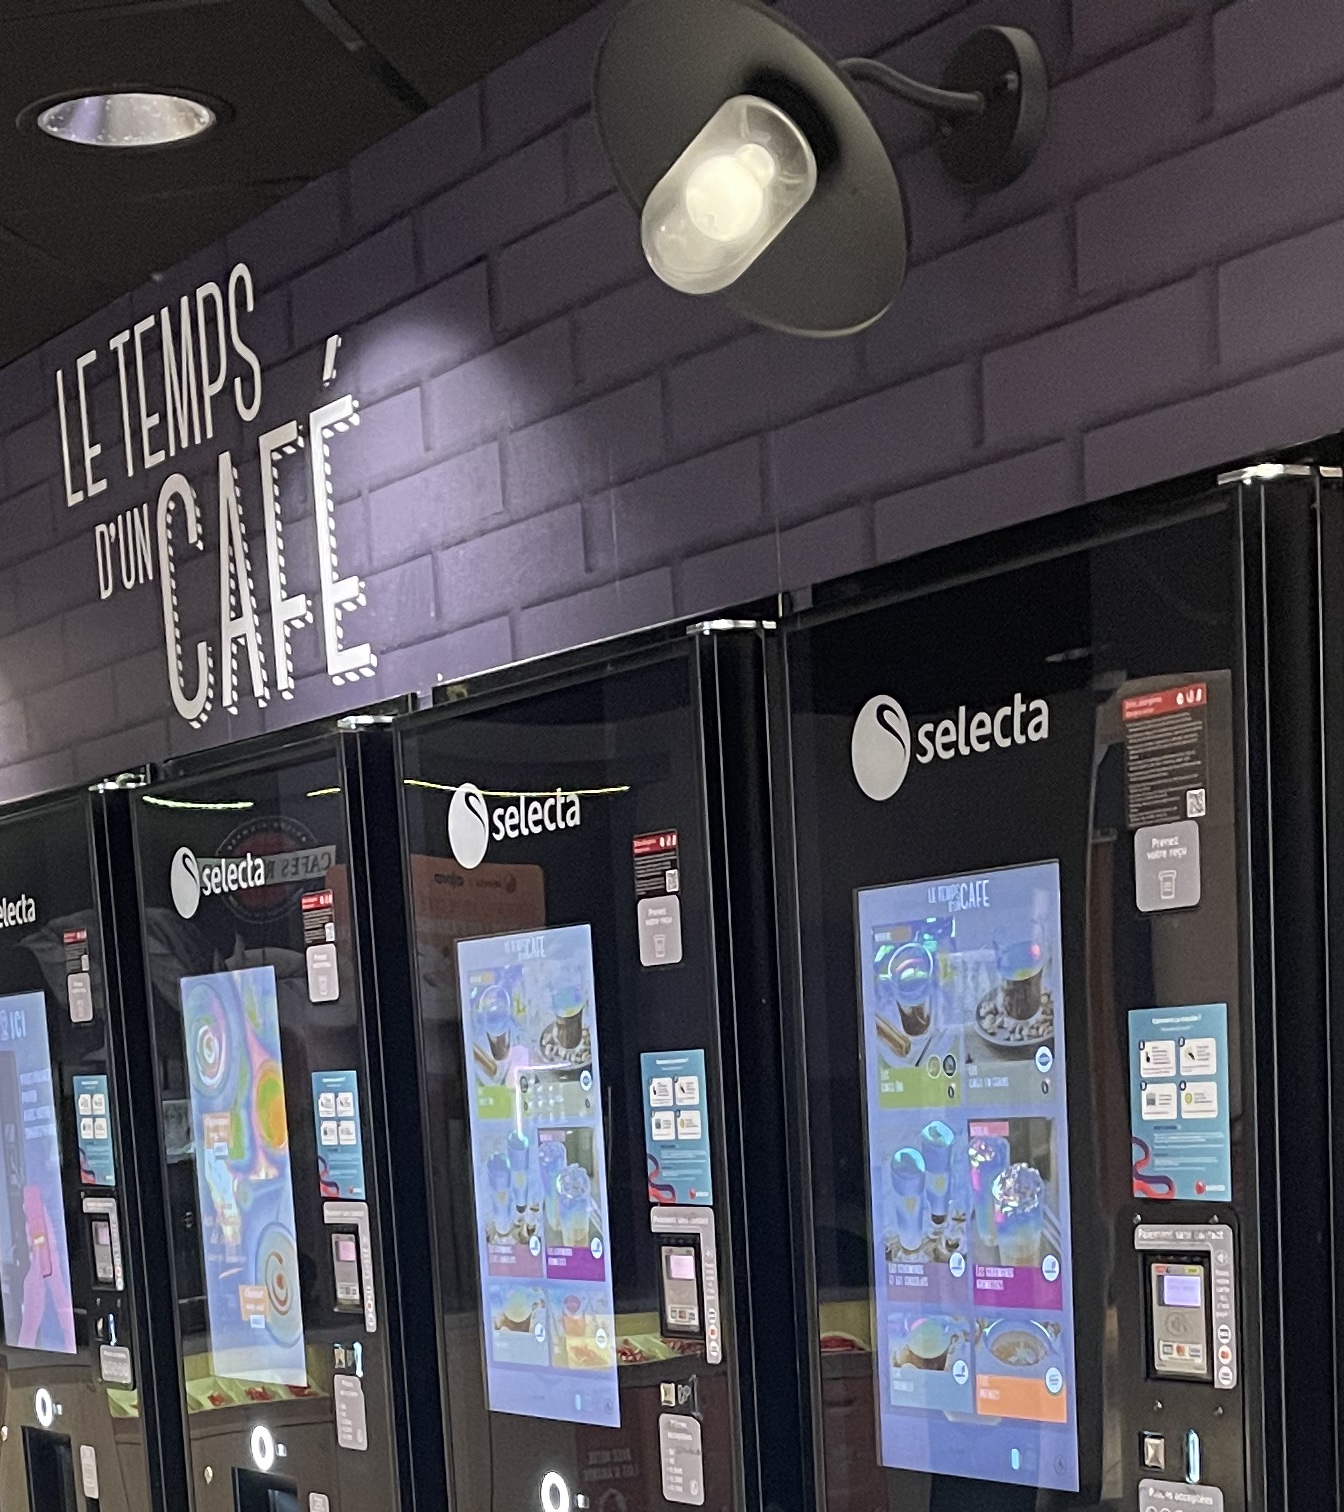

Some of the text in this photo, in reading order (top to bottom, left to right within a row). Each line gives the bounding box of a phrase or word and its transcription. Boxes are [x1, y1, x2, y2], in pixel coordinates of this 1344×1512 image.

[56, 263, 262, 507] LE TEMPS
[94, 503, 154, 600] D'UN
[156, 335, 377, 727] CAFÉ
[916, 692, 1049, 764] selecta
[492, 787, 581, 841] selecta
[202, 852, 265, 896] selecta
